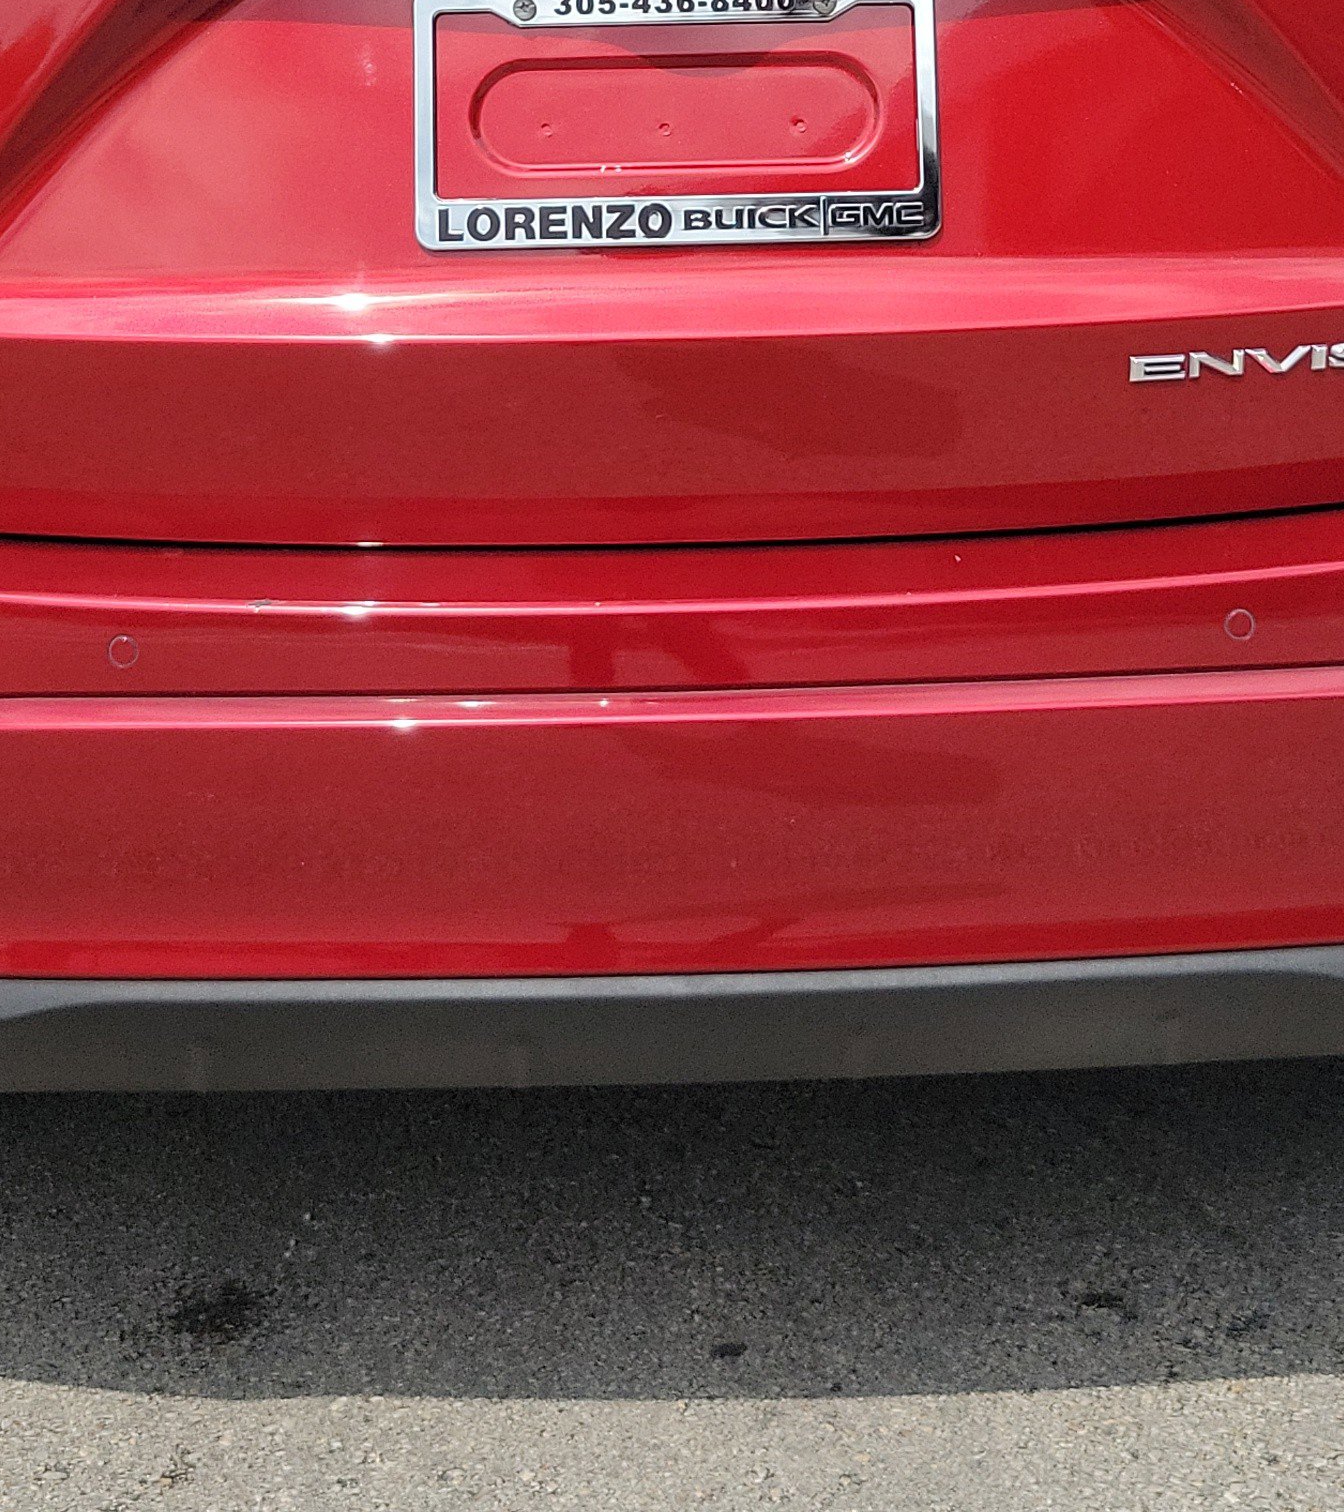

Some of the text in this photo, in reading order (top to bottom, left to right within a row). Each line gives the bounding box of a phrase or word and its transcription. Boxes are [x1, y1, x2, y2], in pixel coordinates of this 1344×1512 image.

[437, 200, 925, 243] LORENZO BUICK GMC
